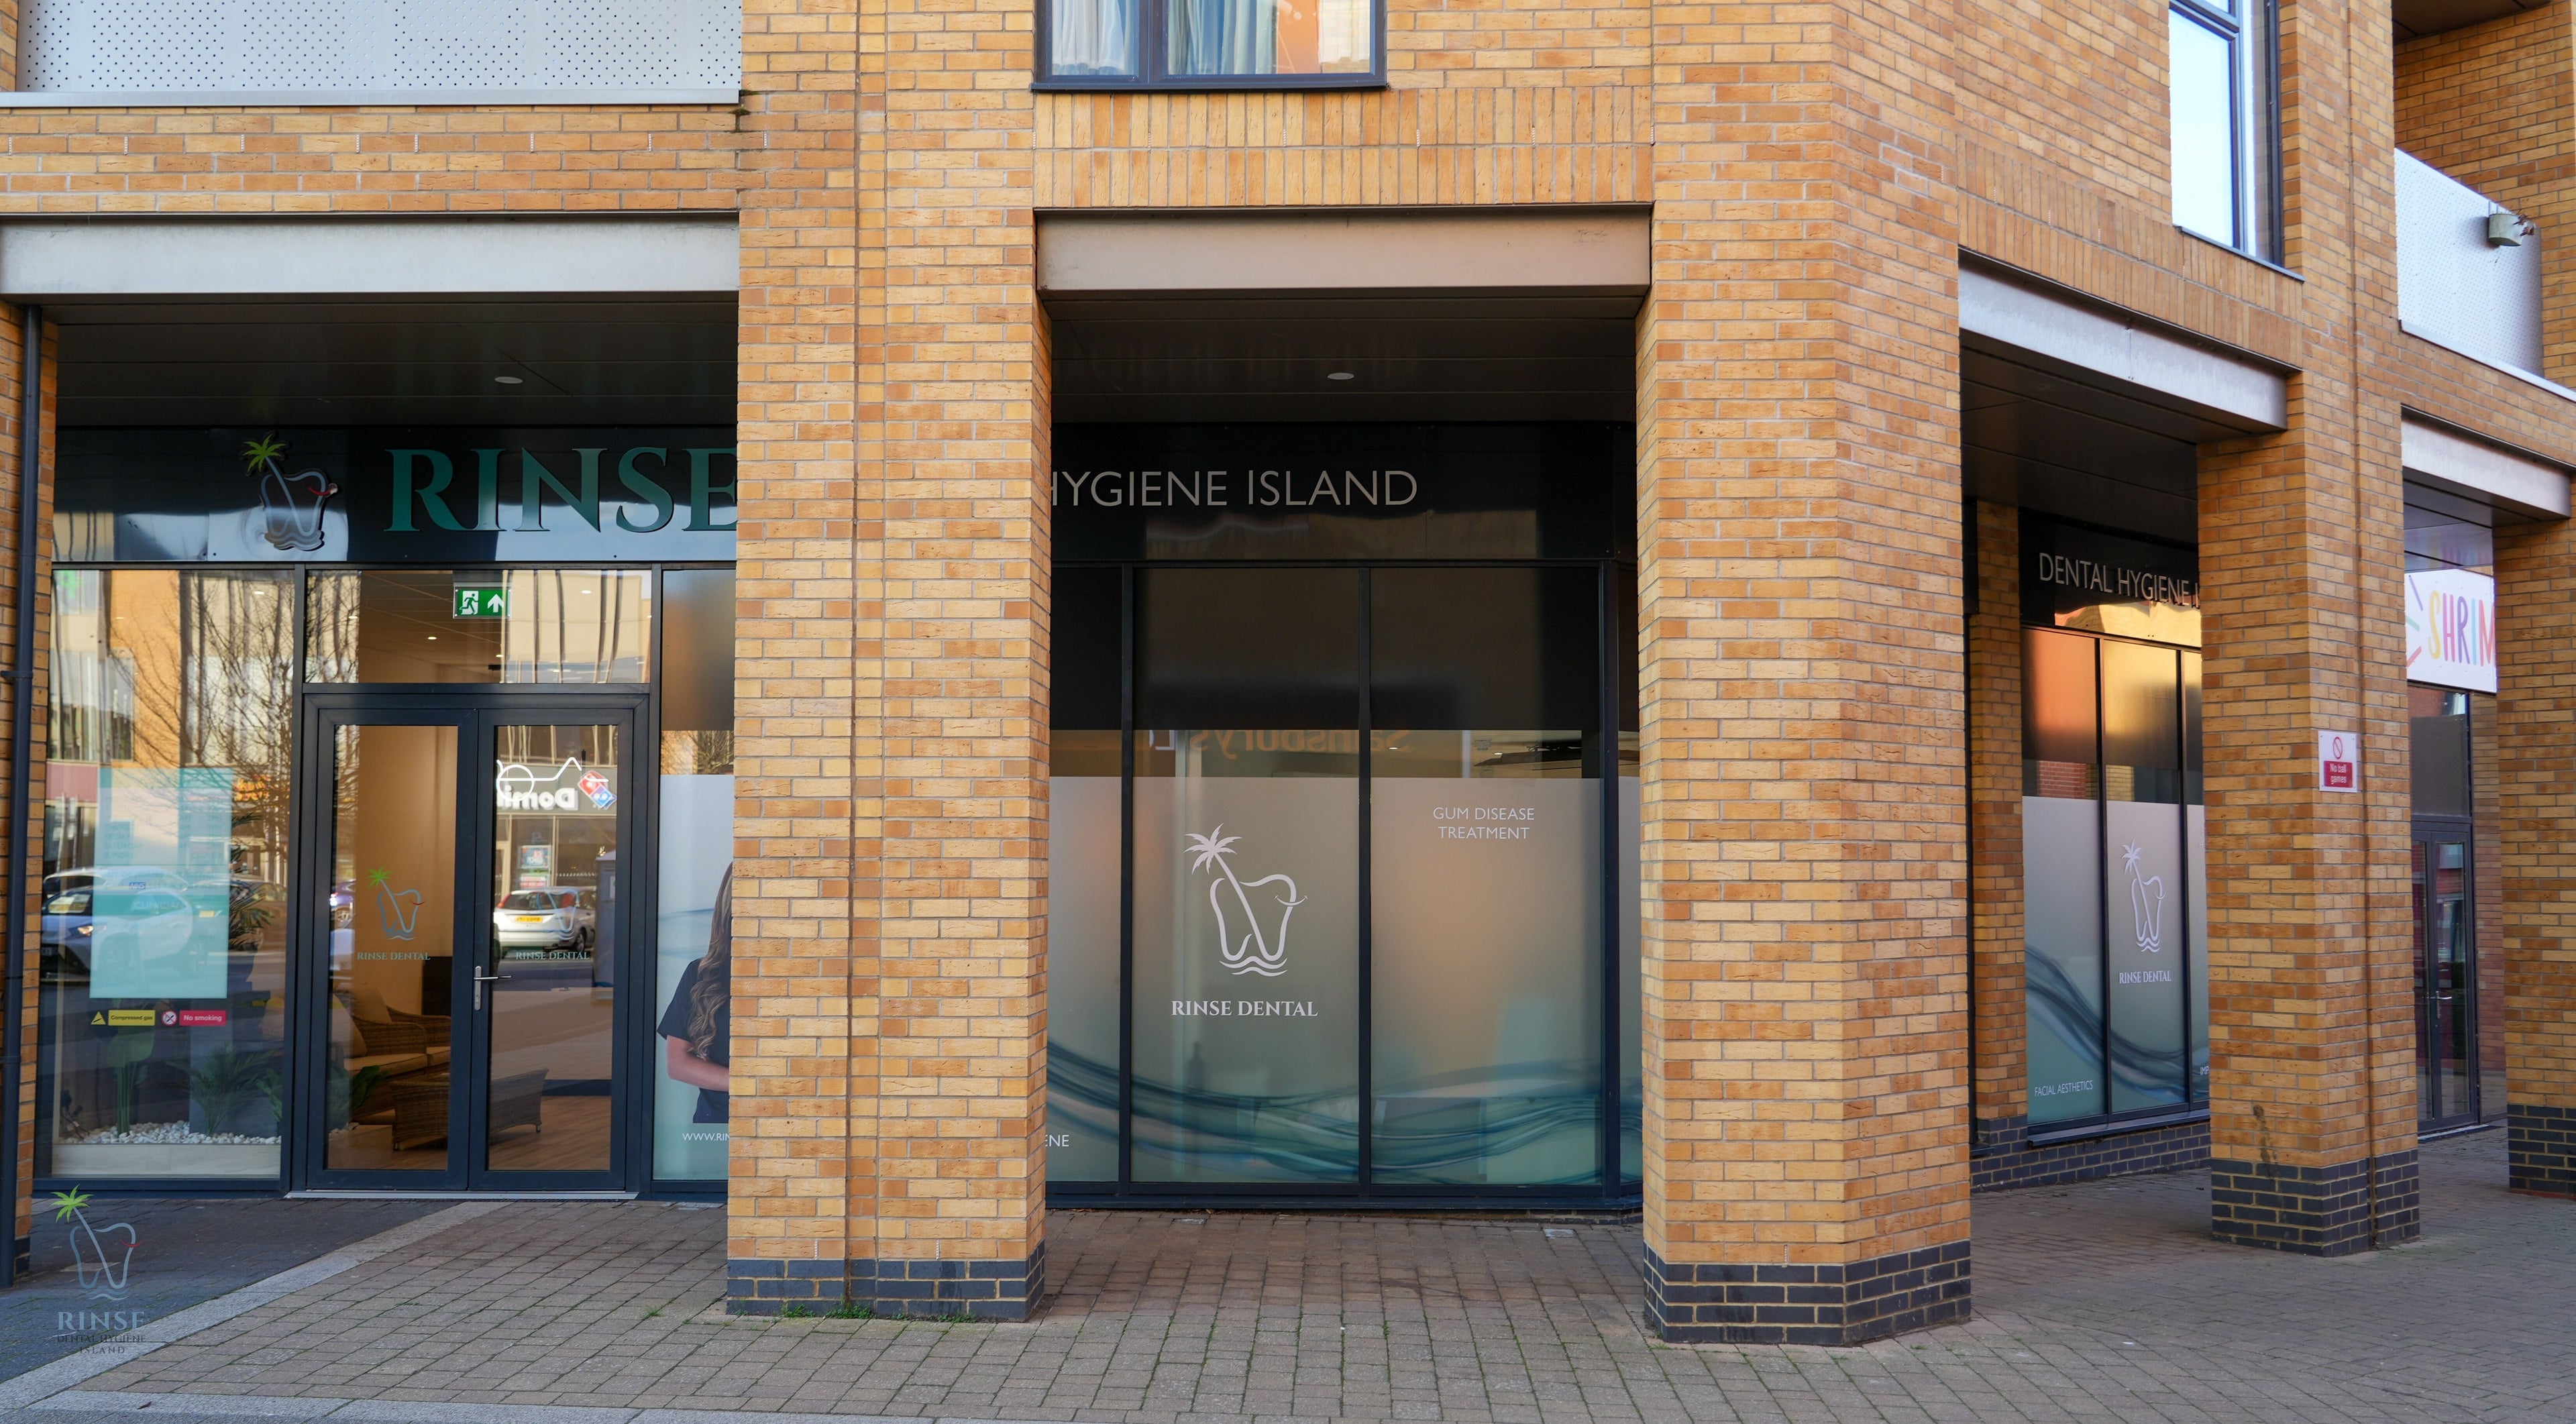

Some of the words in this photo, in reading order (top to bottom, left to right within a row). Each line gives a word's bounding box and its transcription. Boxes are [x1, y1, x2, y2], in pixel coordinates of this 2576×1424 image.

[384, 447, 737, 533] RINSE
[1248, 470, 1417, 506] ISLAND
[2039, 553, 2112, 593] DENTAL
[2118, 567, 2190, 606] HYGIENE
[2428, 590, 2496, 669] SHRIM
[2330, 763, 2337, 772] No
[2338, 764, 2347, 773] ball
[2330, 775, 2347, 785] games
[1433, 808, 1470, 820] GUM
[1474, 808, 1535, 820] DISEASE
[1438, 827, 1530, 839] TREATMENT
[357, 952, 387, 960] RINSE
[390, 952, 431, 960] DENTAL
[516, 952, 546, 960] RINSE
[549, 952, 590, 960] DENTAL
[2119, 972, 2141, 984] RINSE
[2143, 971, 2171, 982] DENTAL
[1171, 1001, 1232, 1017] RINSE
[1237, 1001, 1318, 1017] DENTAL
[2035, 1085, 2055, 1097] FACIAL
[2057, 1080, 2093, 1095] AESTHETICS
